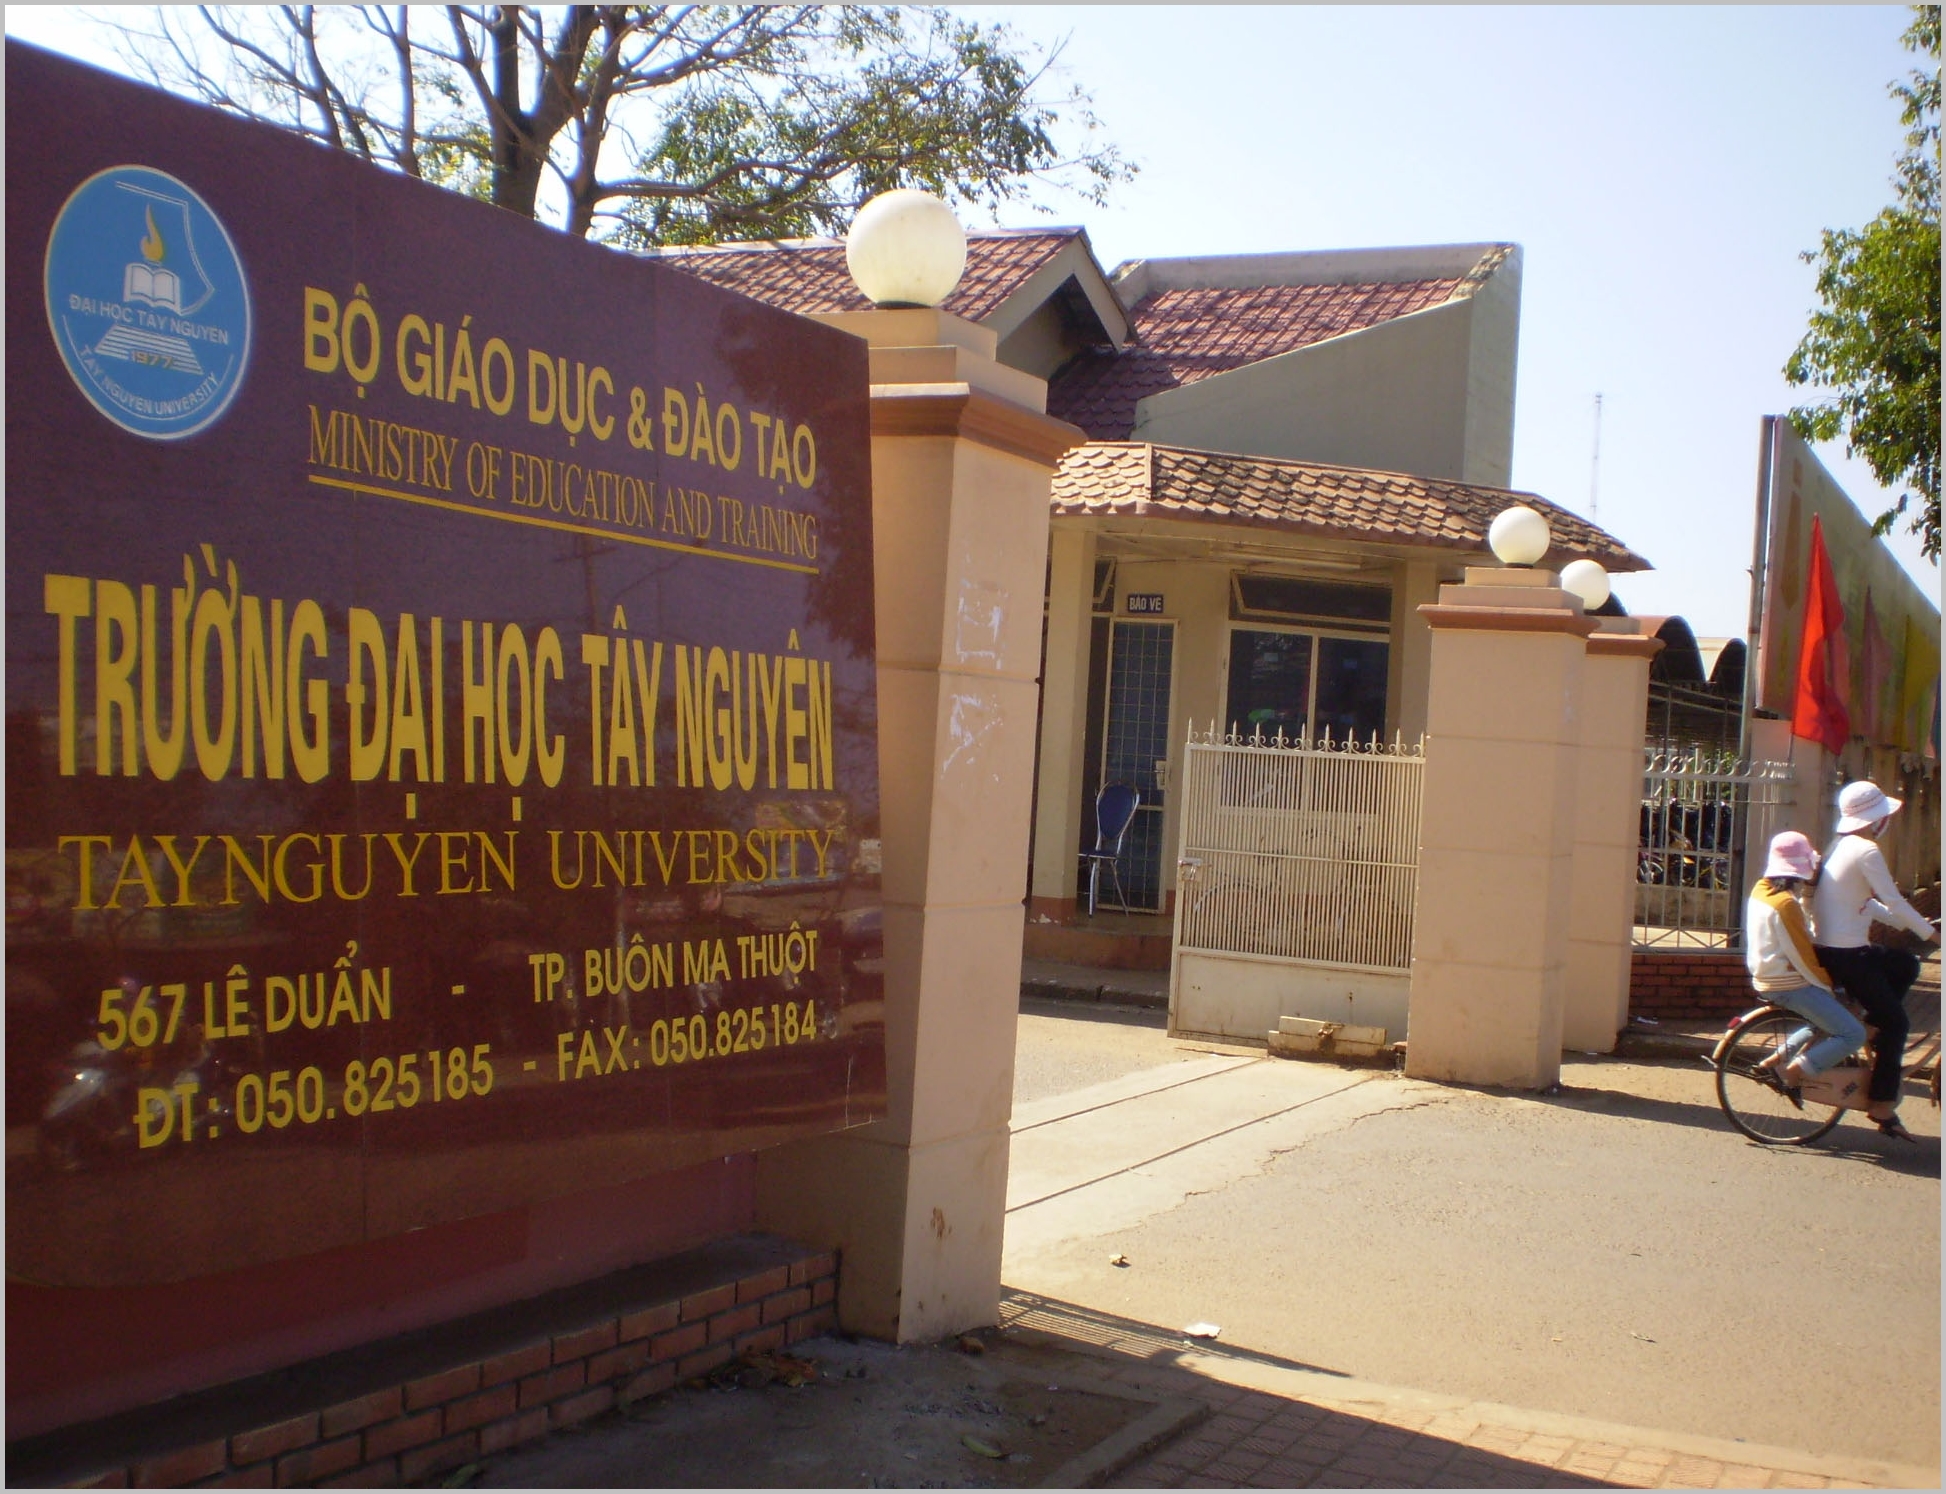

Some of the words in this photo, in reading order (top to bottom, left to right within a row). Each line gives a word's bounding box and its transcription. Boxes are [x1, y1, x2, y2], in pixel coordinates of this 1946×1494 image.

[154, 372, 219, 416] UNIVERSITY
[304, 281, 382, 399] BỘ
[395, 315, 516, 417] GIÁO
[526, 348, 615, 448] DỤC
[626, 386, 654, 452] &
[662, 381, 743, 472] ĐÀO
[750, 410, 818, 496] TẠO
[307, 404, 459, 492] MINISTRY
[466, 440, 503, 500] OF
[509, 450, 656, 529] EDUCATION
[661, 484, 713, 540] AND
[717, 494, 818, 559] TRAINING
[44, 543, 330, 785] TRƯỜNG
[345, 606, 446, 821] ĐẠI
[462, 618, 567, 823] HỌC
[581, 605, 664, 788] TÂY
[675, 628, 835, 792] NGUYÊN
[545, 827, 837, 891] UNIVERSITY
[97, 983, 187, 1051] 567
[203, 963, 251, 1041] LÊ
[264, 939, 392, 1034] DUẨN
[585, 932, 674, 998] BUÔN
[683, 938, 732, 987] MA
[736, 920, 819, 985] THUỘT
[650, 999, 818, 1068] 050.825184
